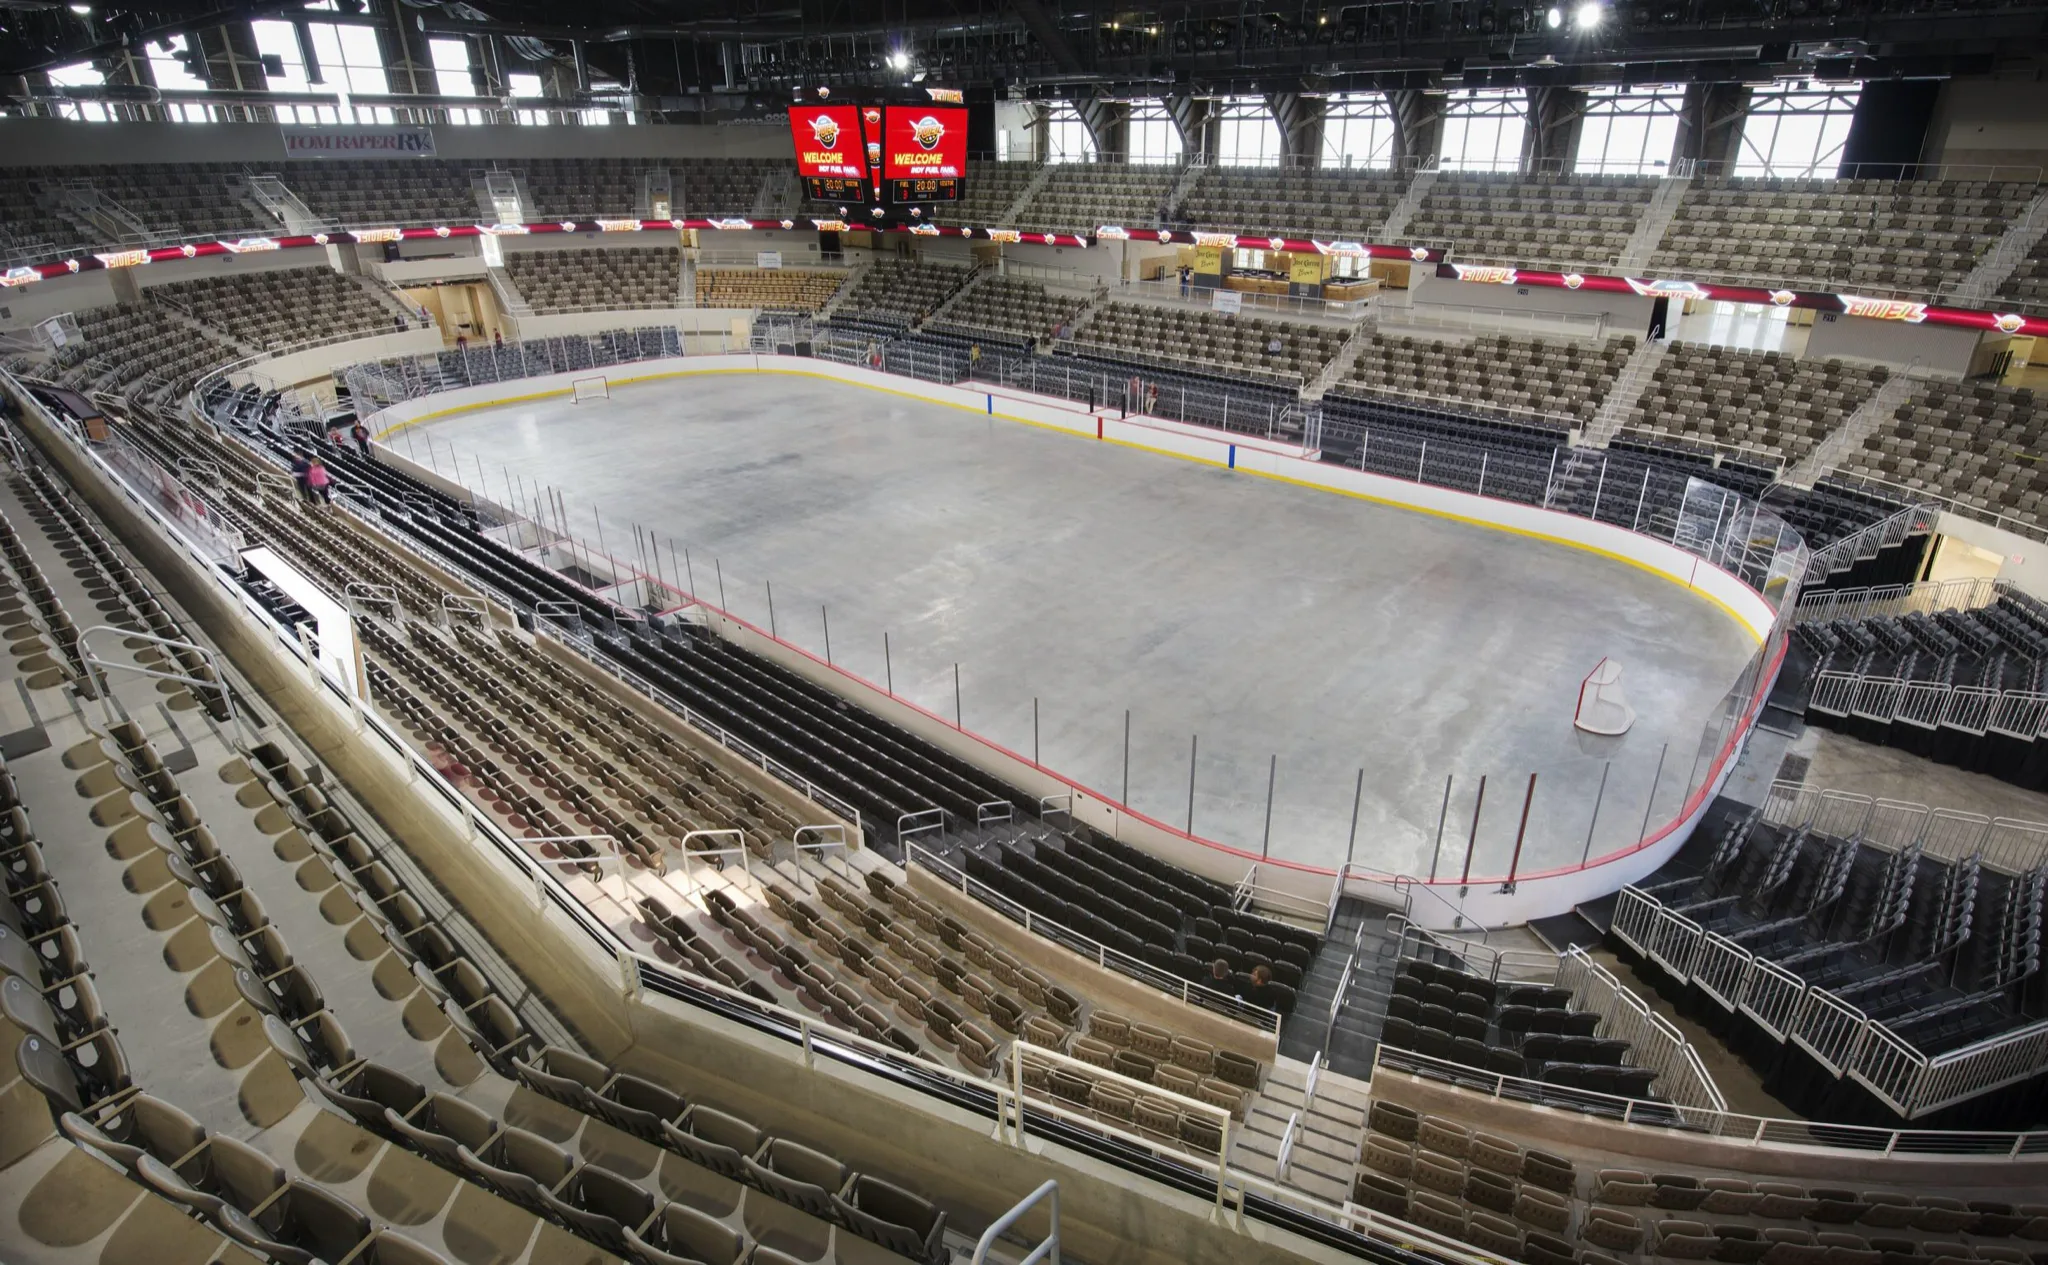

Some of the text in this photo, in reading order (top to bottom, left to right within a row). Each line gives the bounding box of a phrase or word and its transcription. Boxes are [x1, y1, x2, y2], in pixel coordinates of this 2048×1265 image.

[286, 132, 431, 151] TOM RAPER RVs
[803, 152, 844, 164] WELCOME
[894, 153, 943, 165] WELCOME
[916, 180, 936, 191] 20:00
